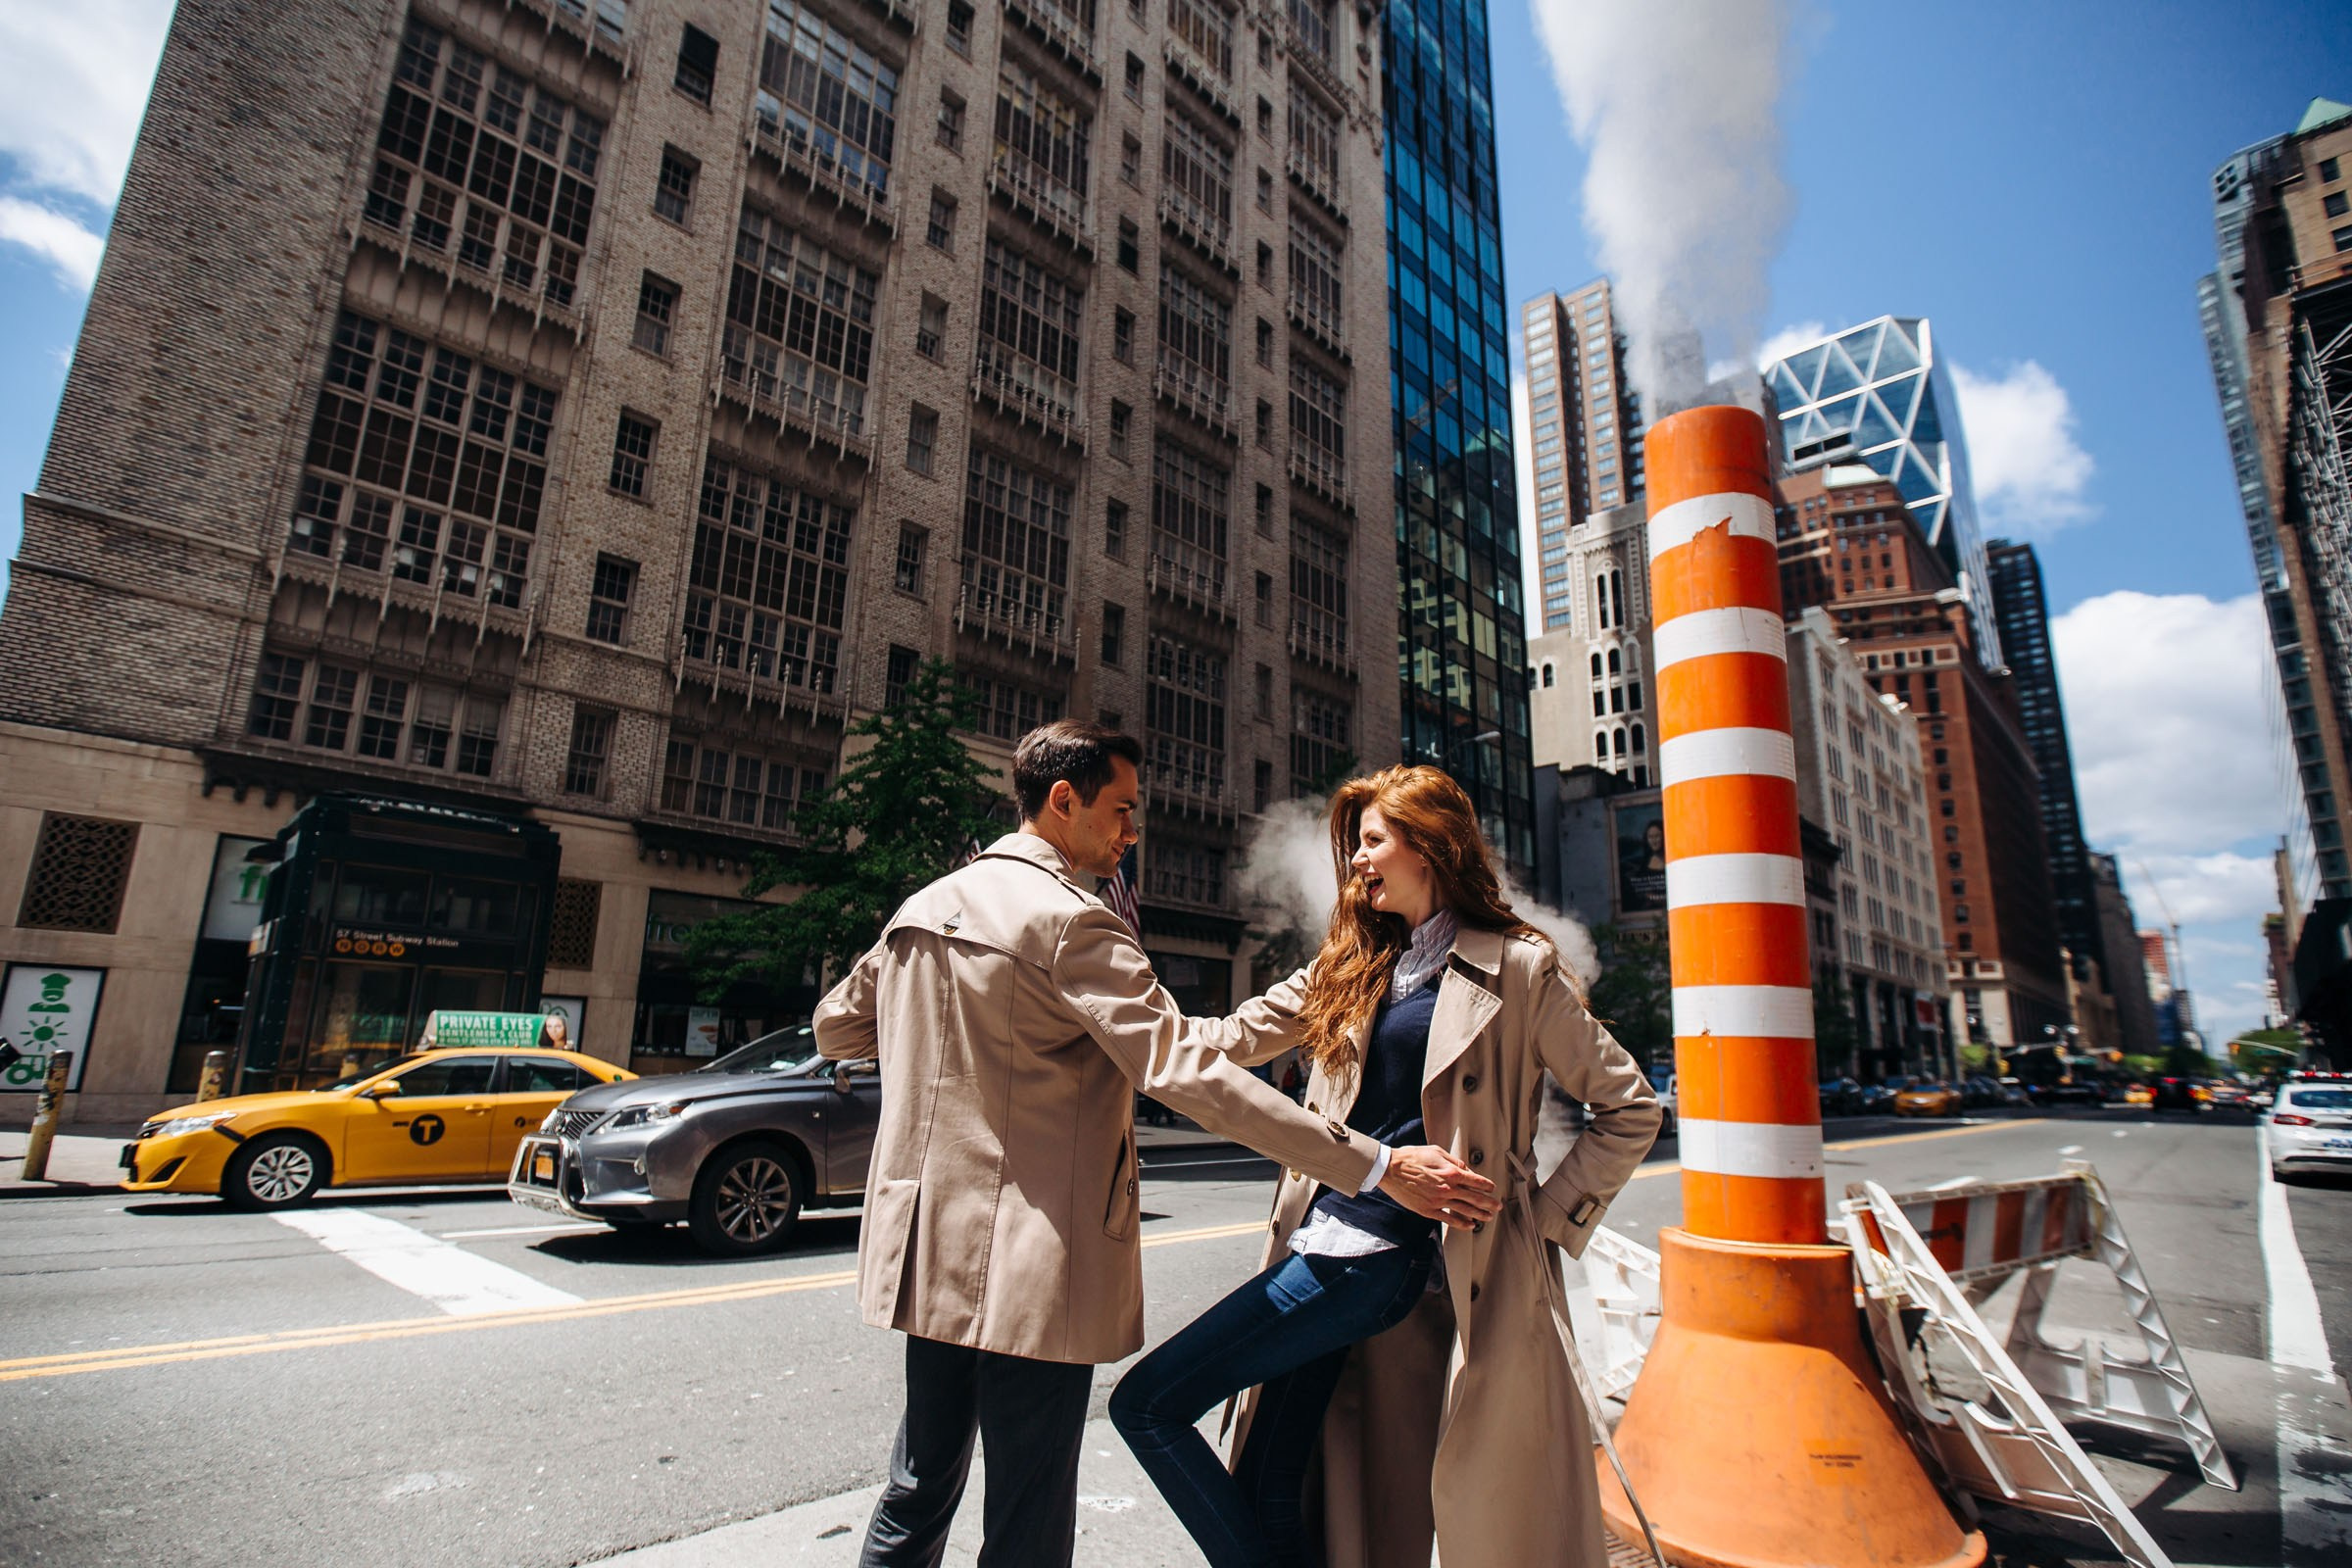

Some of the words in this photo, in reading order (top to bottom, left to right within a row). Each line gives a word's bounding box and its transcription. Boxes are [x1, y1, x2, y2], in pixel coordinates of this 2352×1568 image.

[336, 929, 351, 938] 57
[353, 930, 384, 941] Street
[386, 933, 423, 946] Subway
[425, 935, 460, 947] Station
[440, 1016, 497, 1030] PRIVATE
[502, 1017, 533, 1031] EYES
[439, 1029, 505, 1038] GENTLEMEN'S
[508, 1030, 532, 1039] CLUB
[417, 1120, 438, 1142] T
